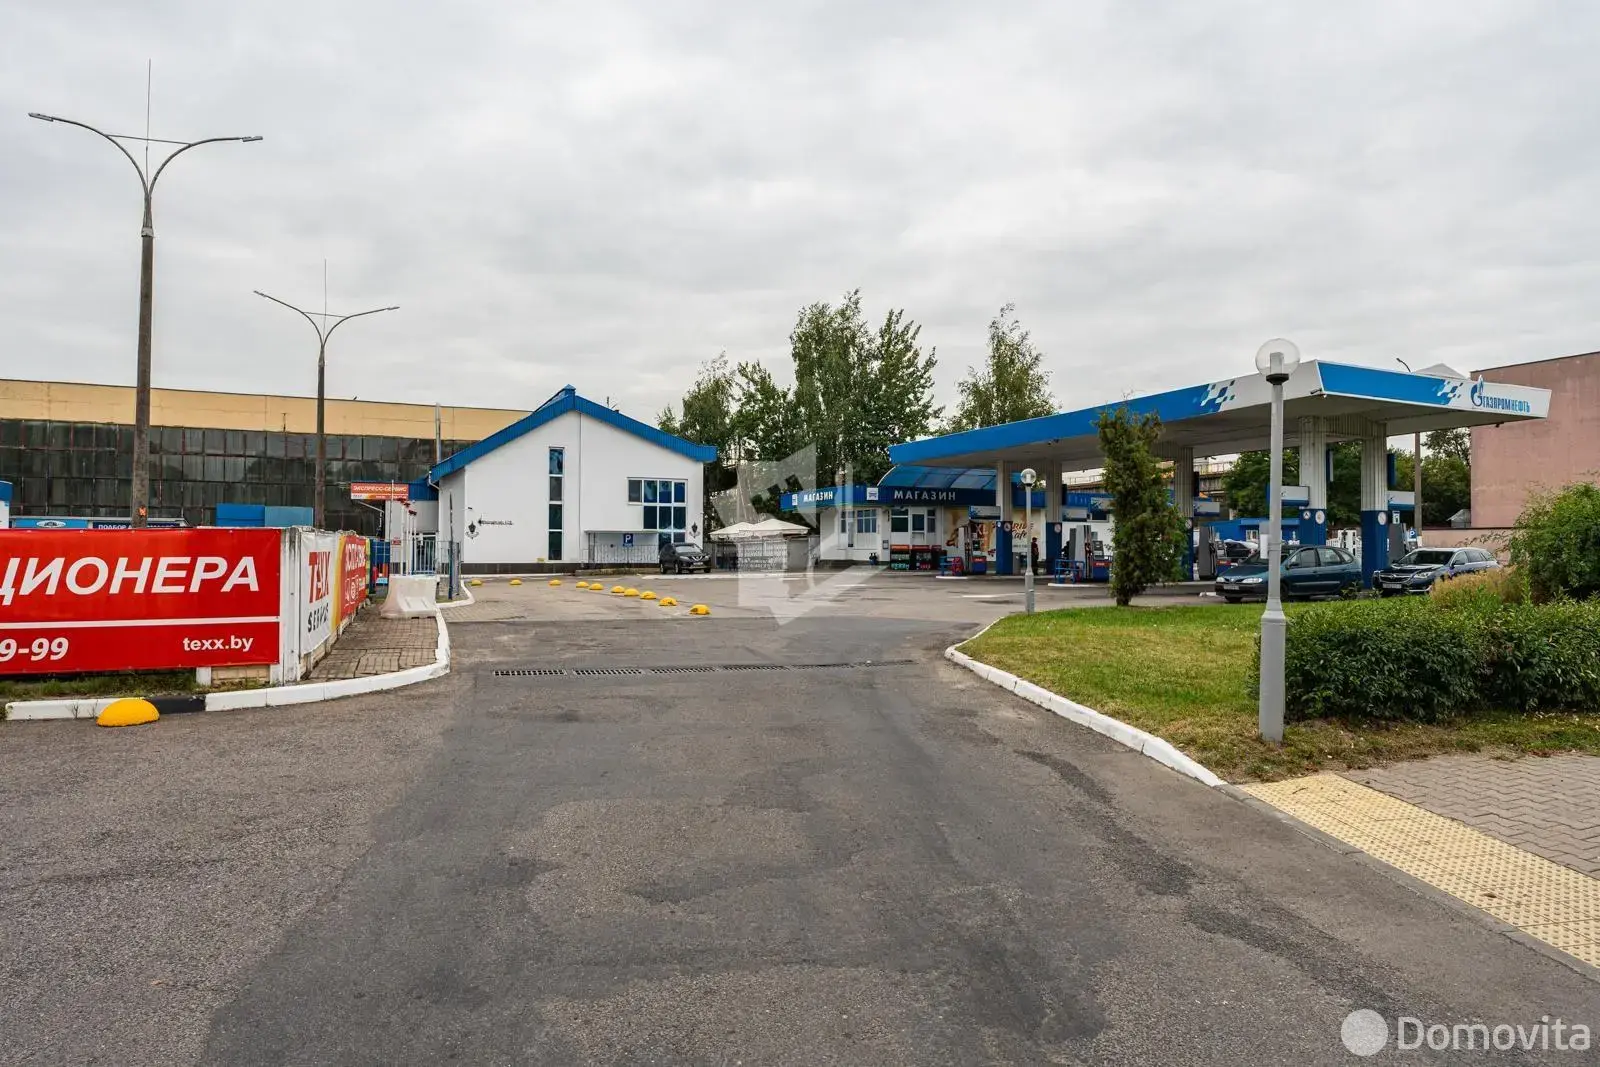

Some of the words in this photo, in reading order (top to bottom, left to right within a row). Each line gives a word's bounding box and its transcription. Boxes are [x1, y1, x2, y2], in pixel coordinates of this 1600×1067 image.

[1482, 395, 1531, 413] ГАЗПРОМНЕФТЬ
[803, 490, 833, 502] МАГАЗИН
[893, 489, 956, 501] МАГАЗИН
[0, 637, 69, 662] 9-99
[182, 634, 254, 653] texx.by
